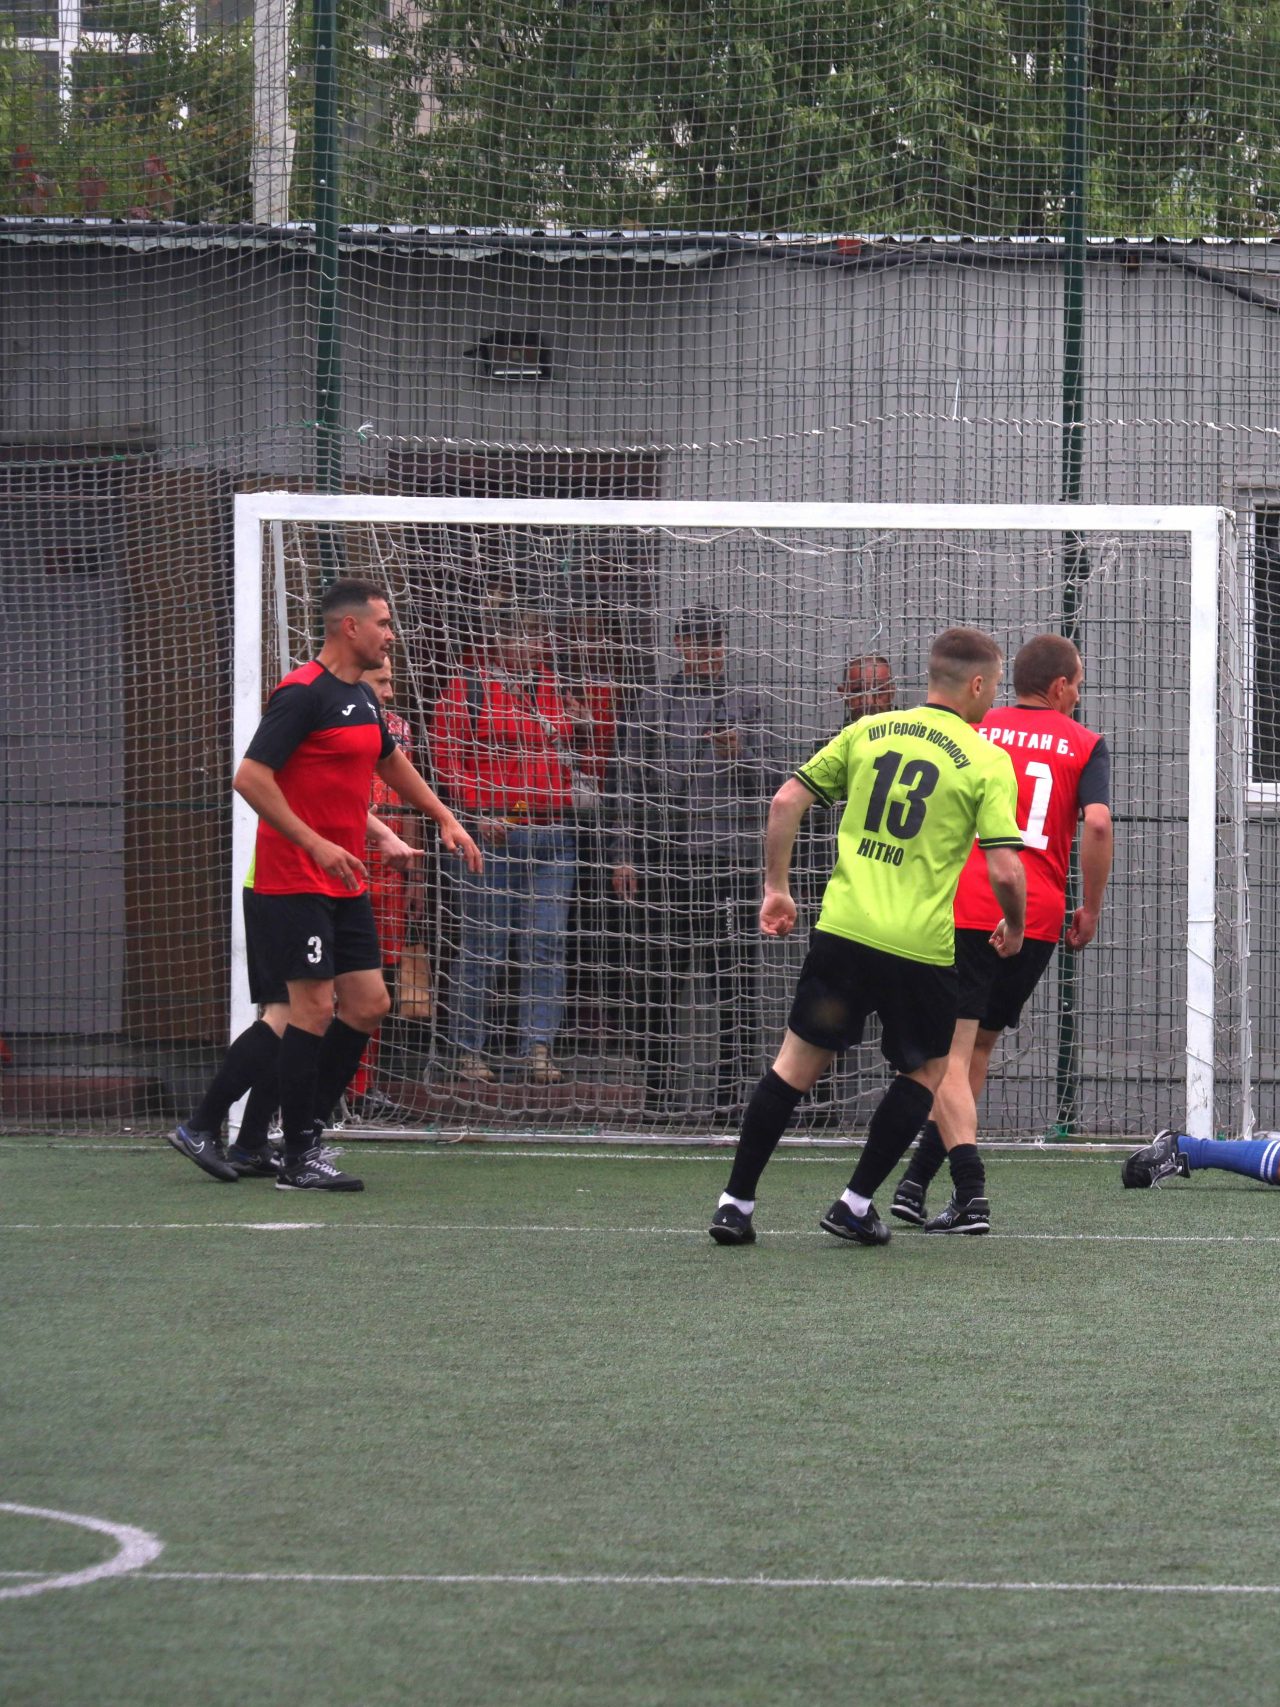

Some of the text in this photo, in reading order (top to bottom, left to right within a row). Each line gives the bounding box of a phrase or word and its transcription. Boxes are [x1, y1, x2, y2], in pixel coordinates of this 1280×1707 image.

[1057, 738, 1075, 757] Б.
[863, 750, 940, 840] 13
[856, 838, 905, 867] НІТКО
[307, 936, 322, 964] 3
